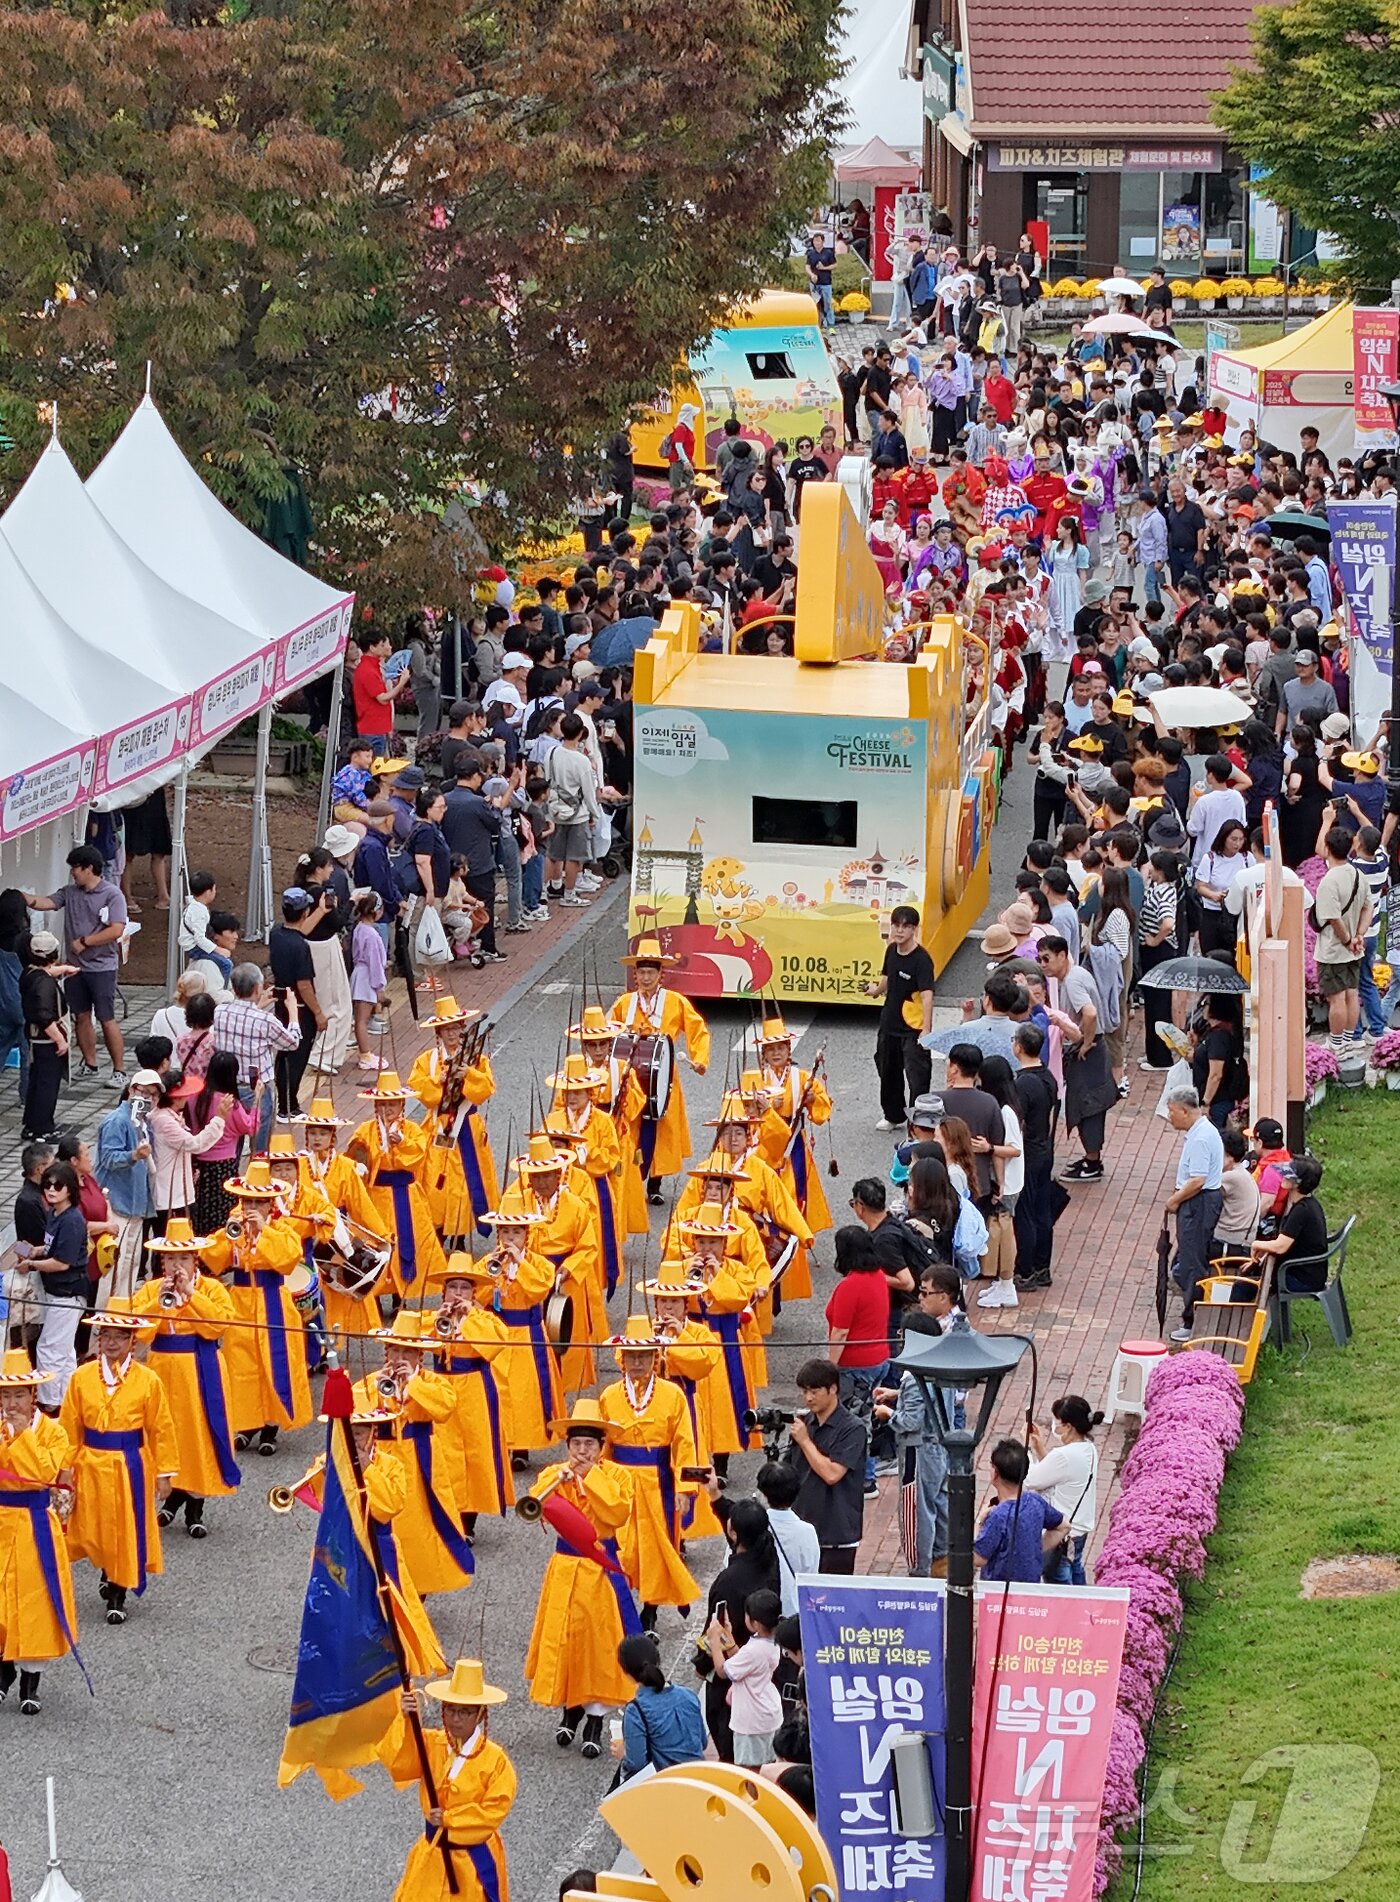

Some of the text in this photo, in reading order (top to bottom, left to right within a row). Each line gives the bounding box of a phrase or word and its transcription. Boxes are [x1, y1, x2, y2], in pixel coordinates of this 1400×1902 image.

[1360, 338, 1391, 354] 임실
[1367, 354, 1384, 374] N
[642, 728, 670, 737] 이제
[671, 732, 696, 748] 임실
[853, 736, 890, 752] CHEESE
[780, 975, 884, 998] 임실N치즈축
